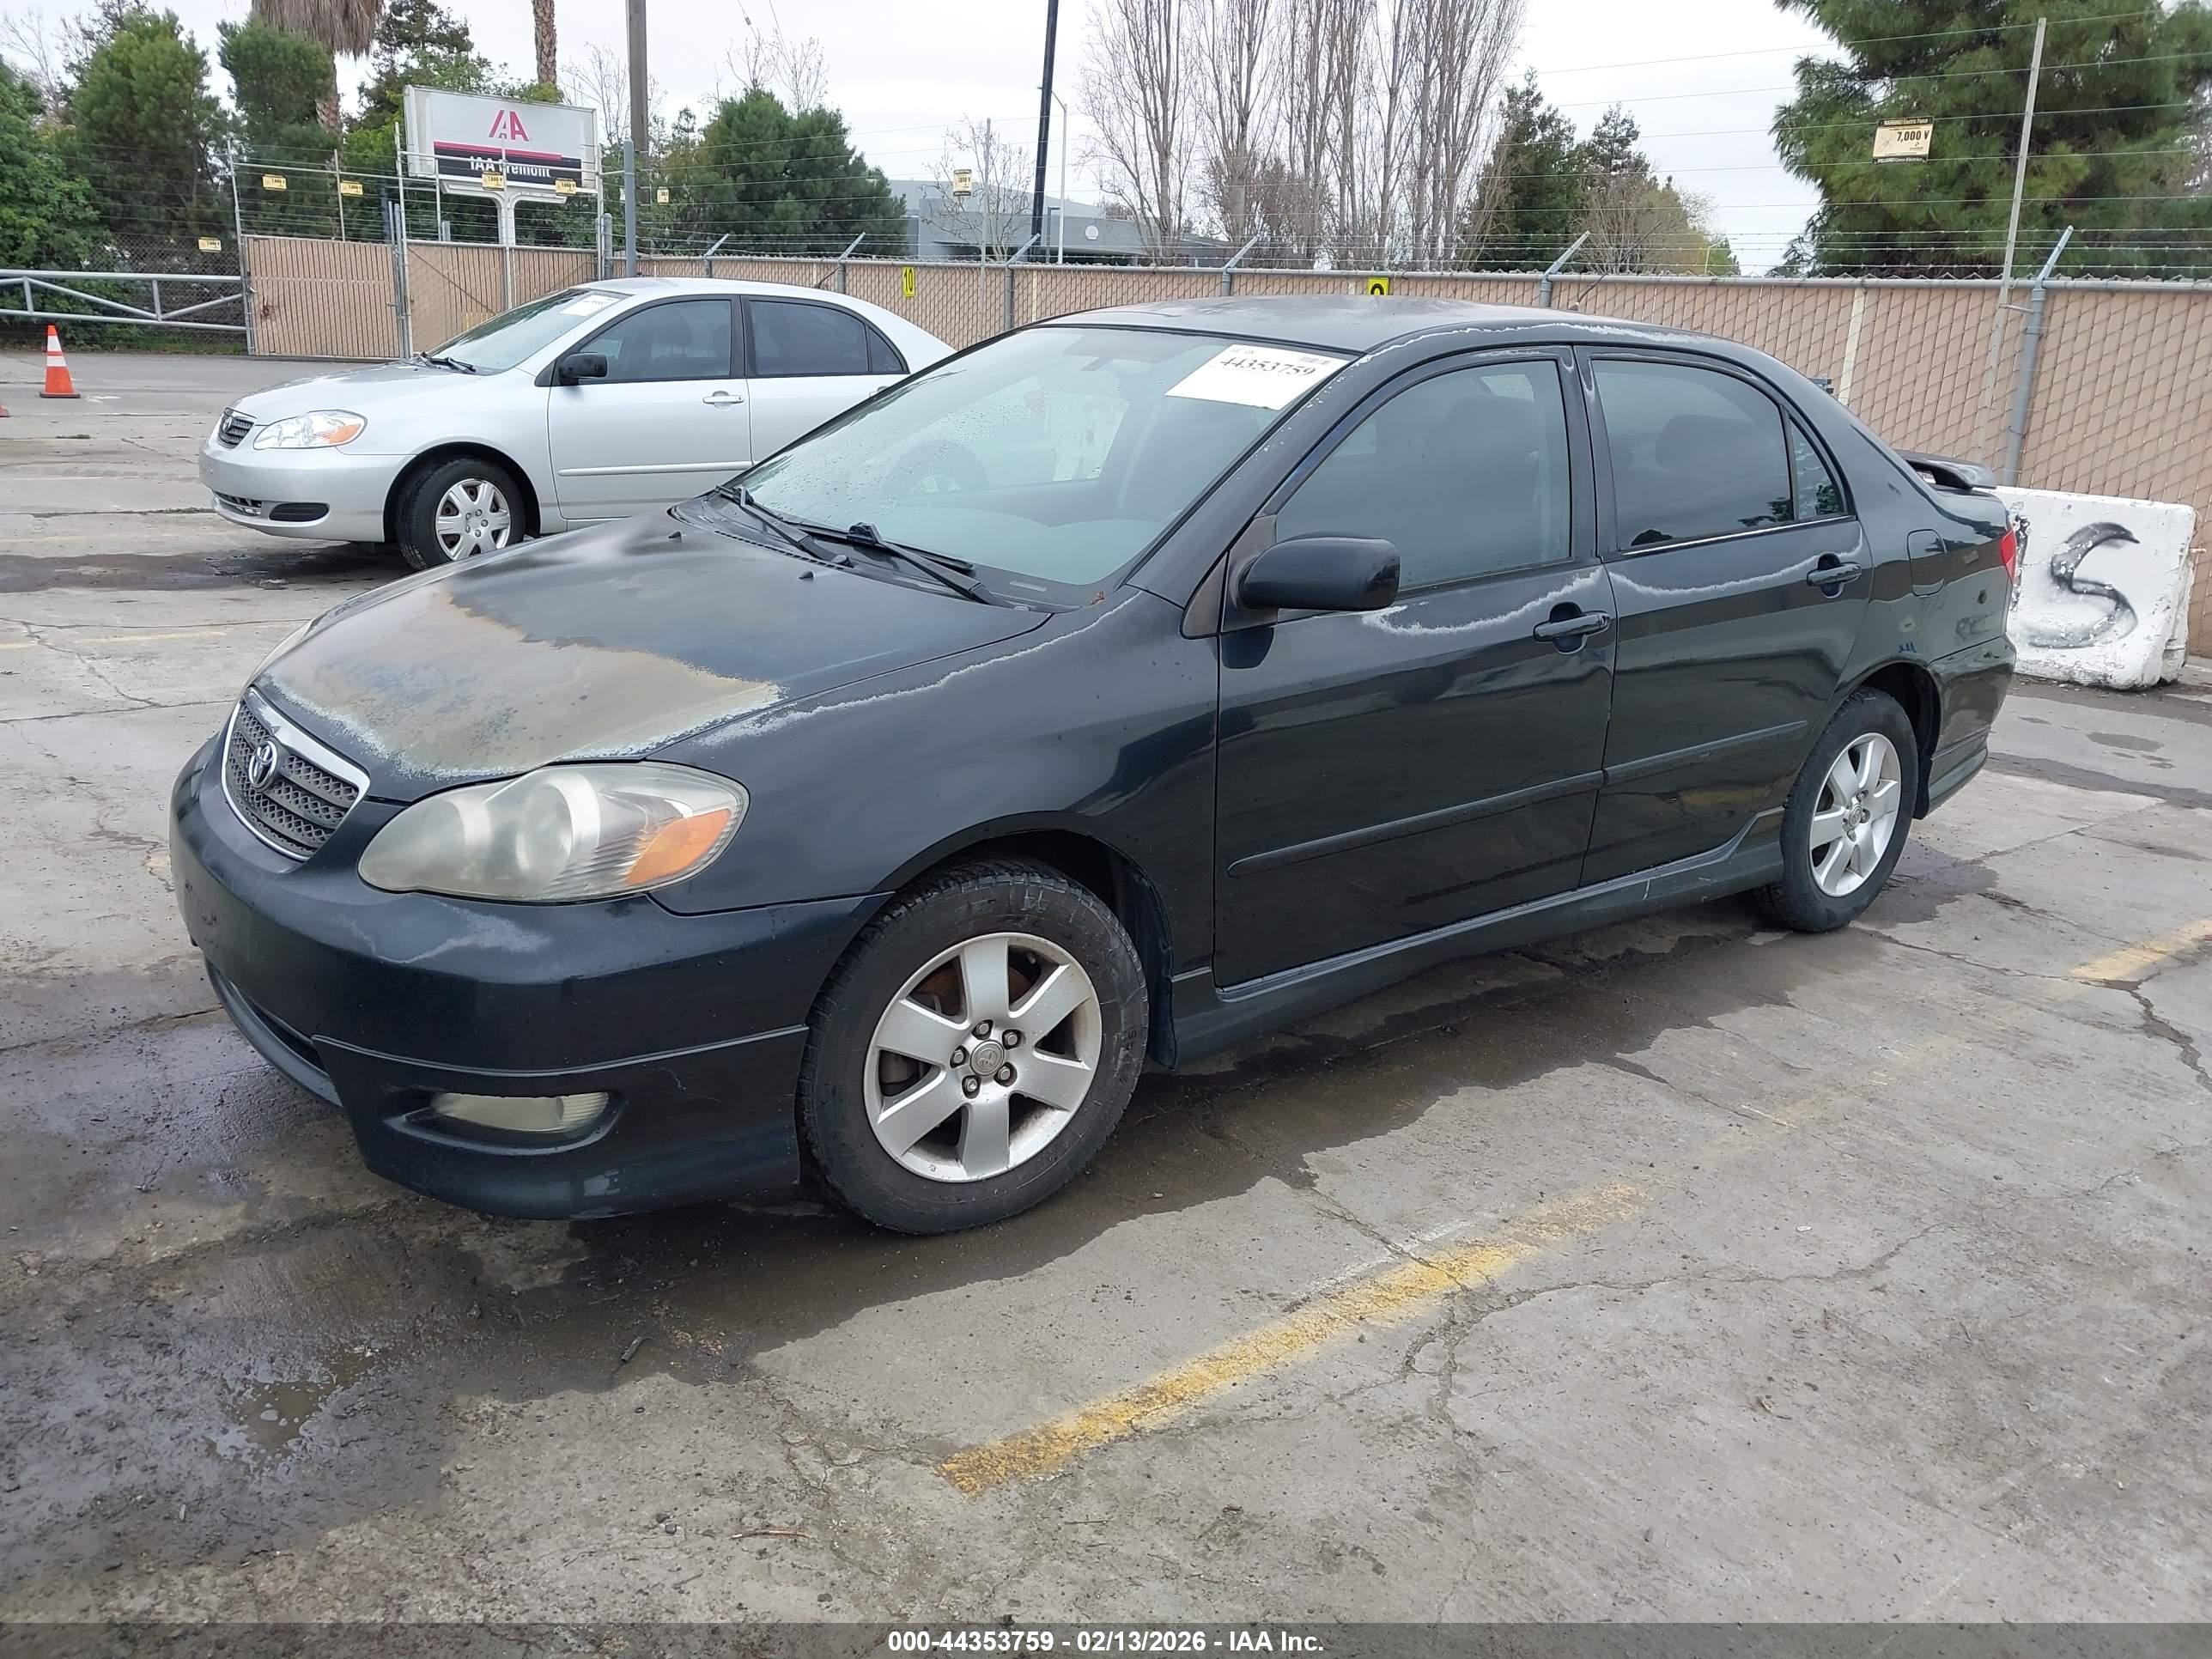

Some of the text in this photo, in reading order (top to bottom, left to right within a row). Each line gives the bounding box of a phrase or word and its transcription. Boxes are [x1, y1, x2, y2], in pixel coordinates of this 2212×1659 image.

[1897, 130, 1930, 143] 7,000 V
[470, 155, 495, 172] IAA
[903, 267, 914, 293] 10
[1220, 356, 1316, 376] 44353759
